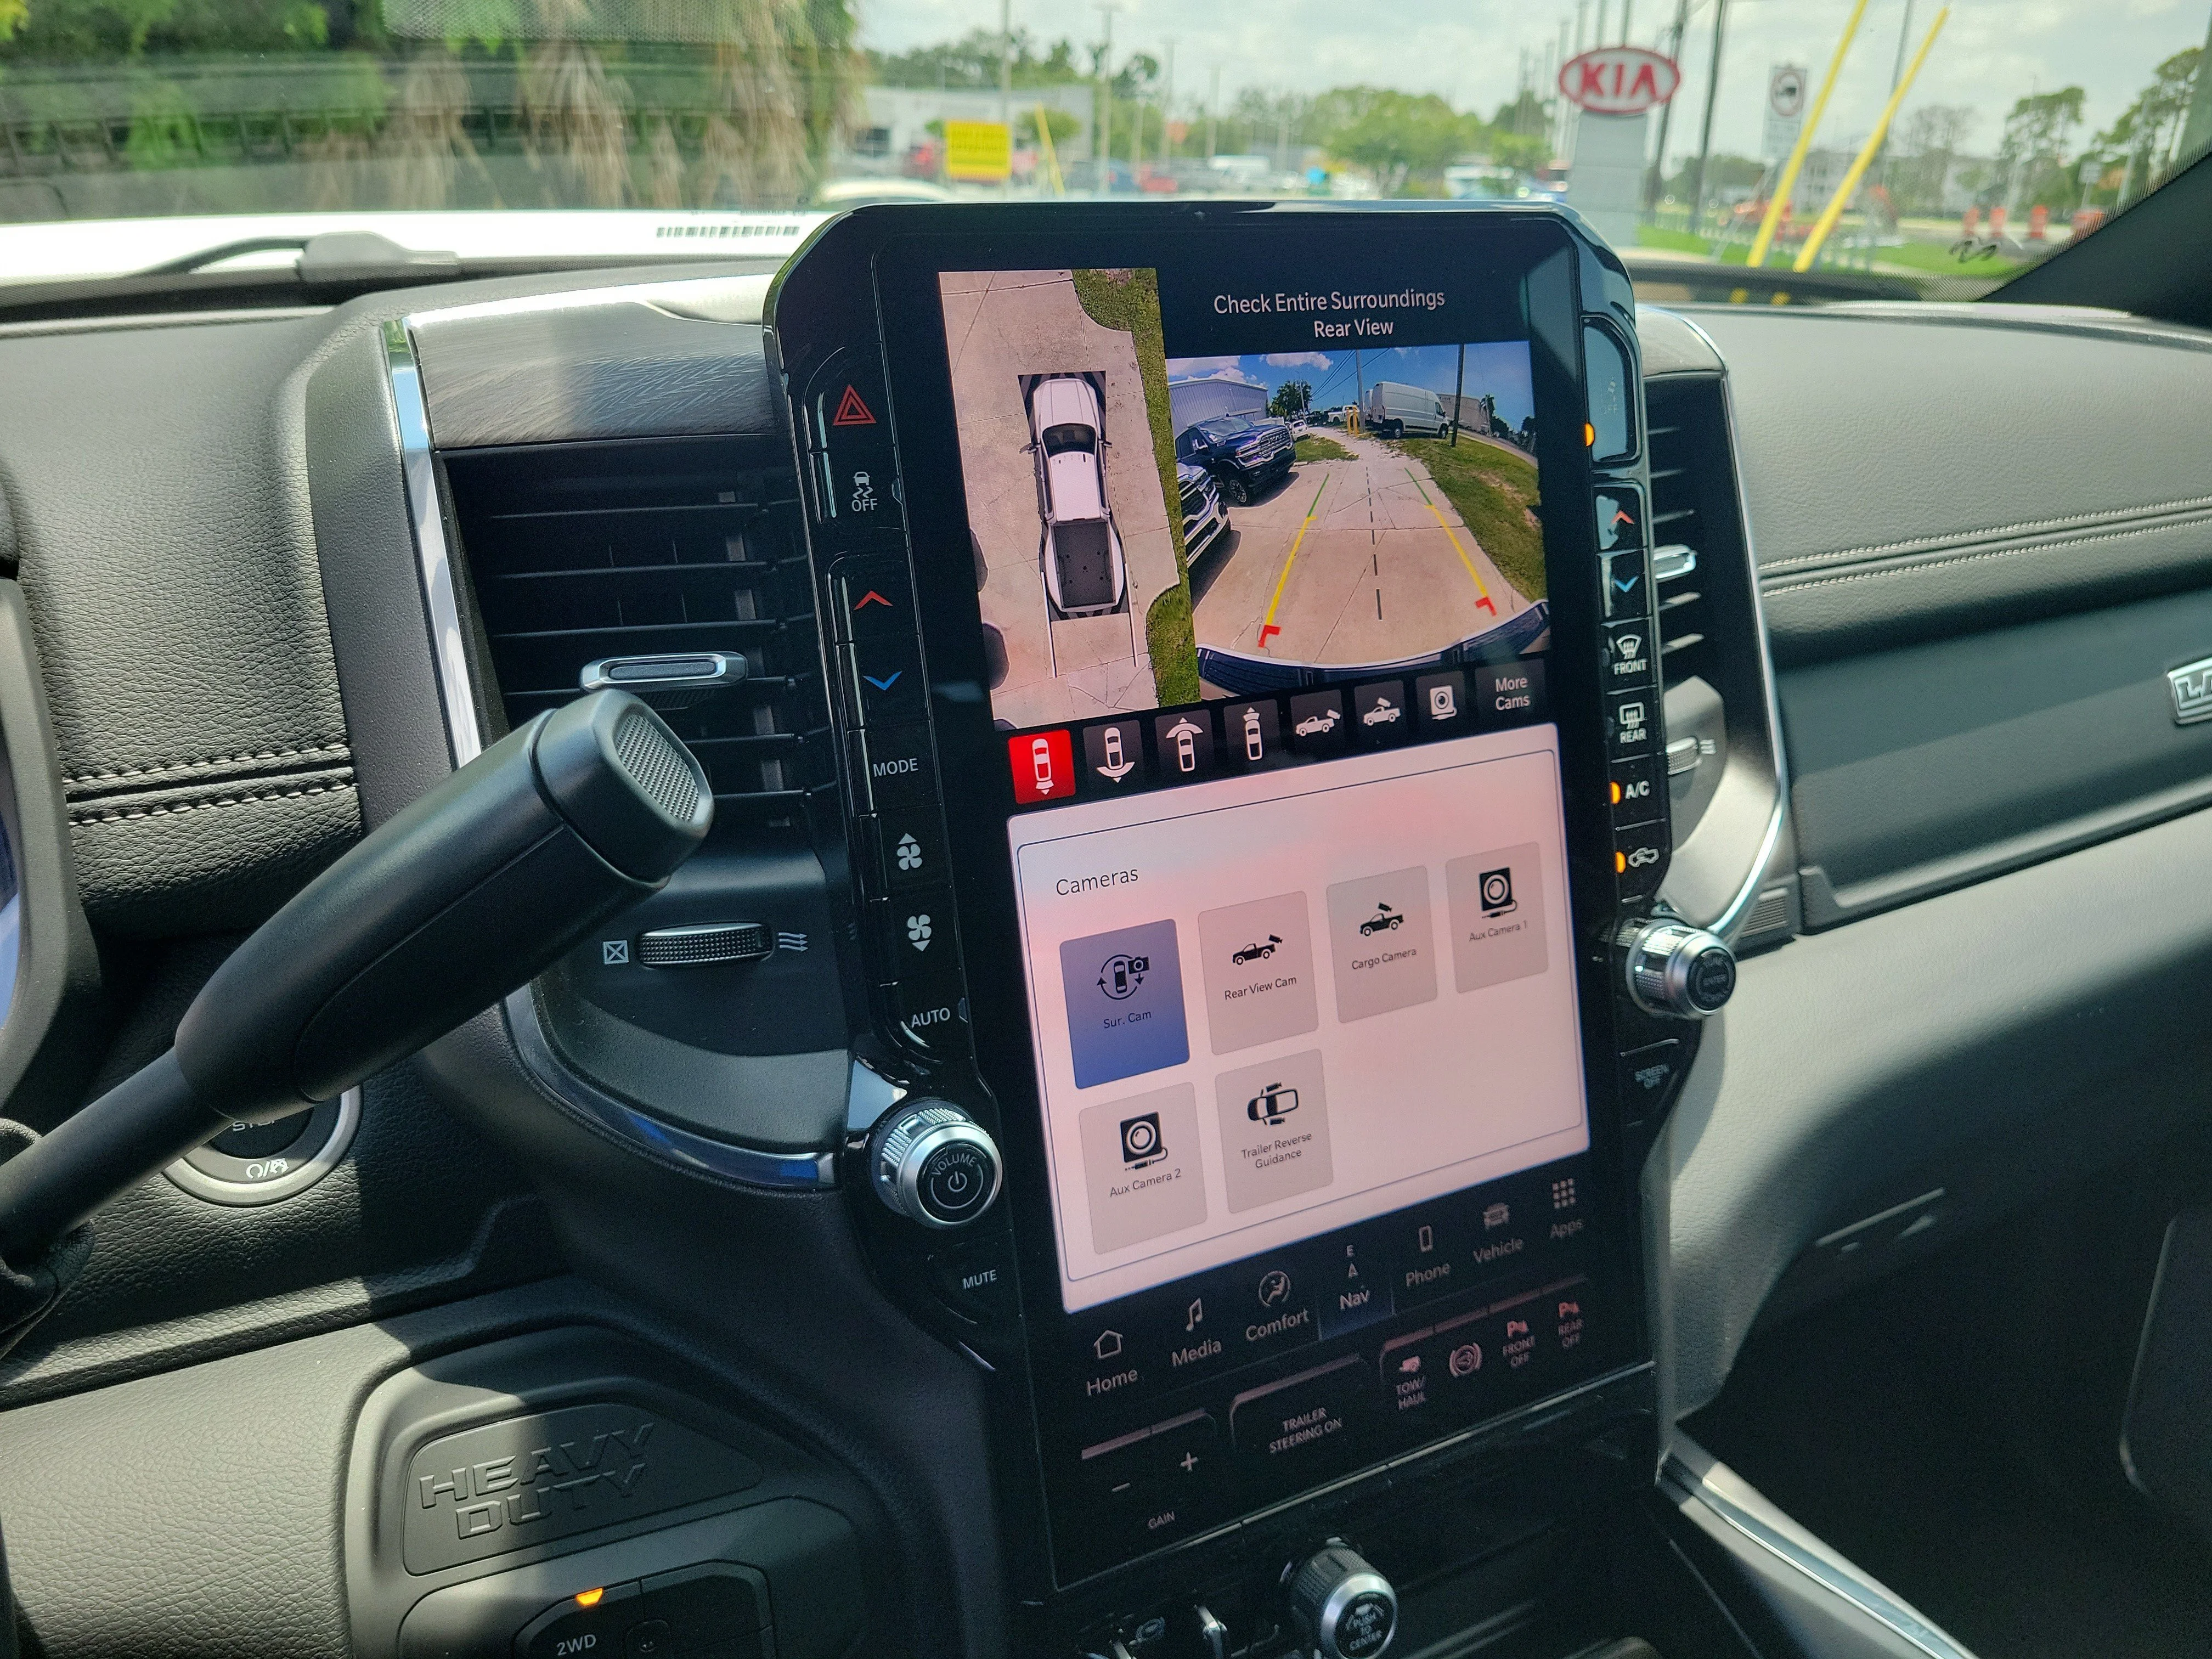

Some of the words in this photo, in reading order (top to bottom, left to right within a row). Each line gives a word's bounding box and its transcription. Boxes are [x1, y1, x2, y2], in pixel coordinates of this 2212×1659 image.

[1581, 62, 1657, 99] KIA
[1214, 293, 1271, 314] Check
[1276, 291, 1327, 312] Entire
[1331, 289, 1445, 311] Surroundings
[1314, 320, 1351, 338] Rear
[1355, 319, 1393, 336] View
[851, 498, 878, 512] OFF
[1613, 659, 1647, 675] FRONT
[1496, 676, 1528, 692] More
[1496, 695, 1531, 711] Cams
[1620, 728, 1647, 744] REAR
[873, 758, 919, 777] MODE
[1625, 781, 1650, 800] A/C
[1056, 868, 1138, 896] Cameras
[1469, 931, 1486, 943] Aux
[1488, 922, 1521, 938] Camera
[1522, 920, 1528, 929] 1
[1352, 955, 1380, 970] Cargo
[1382, 948, 1417, 963] Camera
[1224, 988, 1248, 1001] Rear
[1249, 982, 1273, 995] View
[1275, 977, 1297, 989] Cam
[911, 1007, 951, 1028] AUTO
[1103, 1017, 1125, 1029] Sur.
[1128, 1010, 1152, 1023] Cam
[1242, 1142, 1272, 1160] Trailer
[1274, 1132, 1313, 1150] Reverse
[932, 1153, 977, 1177] VOLUME
[1255, 1149, 1302, 1169] Guidance
[1110, 1182, 1130, 1198] Aux
[1132, 1172, 1172, 1191] Camera
[1175, 1168, 1182, 1179] 2
[1550, 1218, 1584, 1239] Apps
[1346, 1245, 1355, 1258] E
[1474, 1237, 1524, 1263] Vehicle
[962, 1269, 997, 1290] MUTE
[1406, 1263, 1451, 1287] Phone
[1339, 1290, 1370, 1310] Nav
[1245, 1308, 1310, 1342] Comfort
[1503, 1335, 1535, 1357] FRONT
[1562, 1333, 1581, 1350] OFF
[1171, 1339, 1222, 1367] Media
[1510, 1351, 1530, 1368] OFF
[1087, 1368, 1138, 1396] Home
[1396, 1375, 1426, 1396] TOW/
[1398, 1391, 1426, 1410] HAUL
[1282, 1407, 1327, 1432] TRAILER
[1269, 1424, 1323, 1454] STEERING
[1325, 1417, 1343, 1432] ON
[419, 1423, 654, 1509] HEAVY
[455, 1463, 646, 1540] DUTY
[1148, 1510, 1175, 1530] GAIN
[556, 1633, 597, 1657] 2WD
